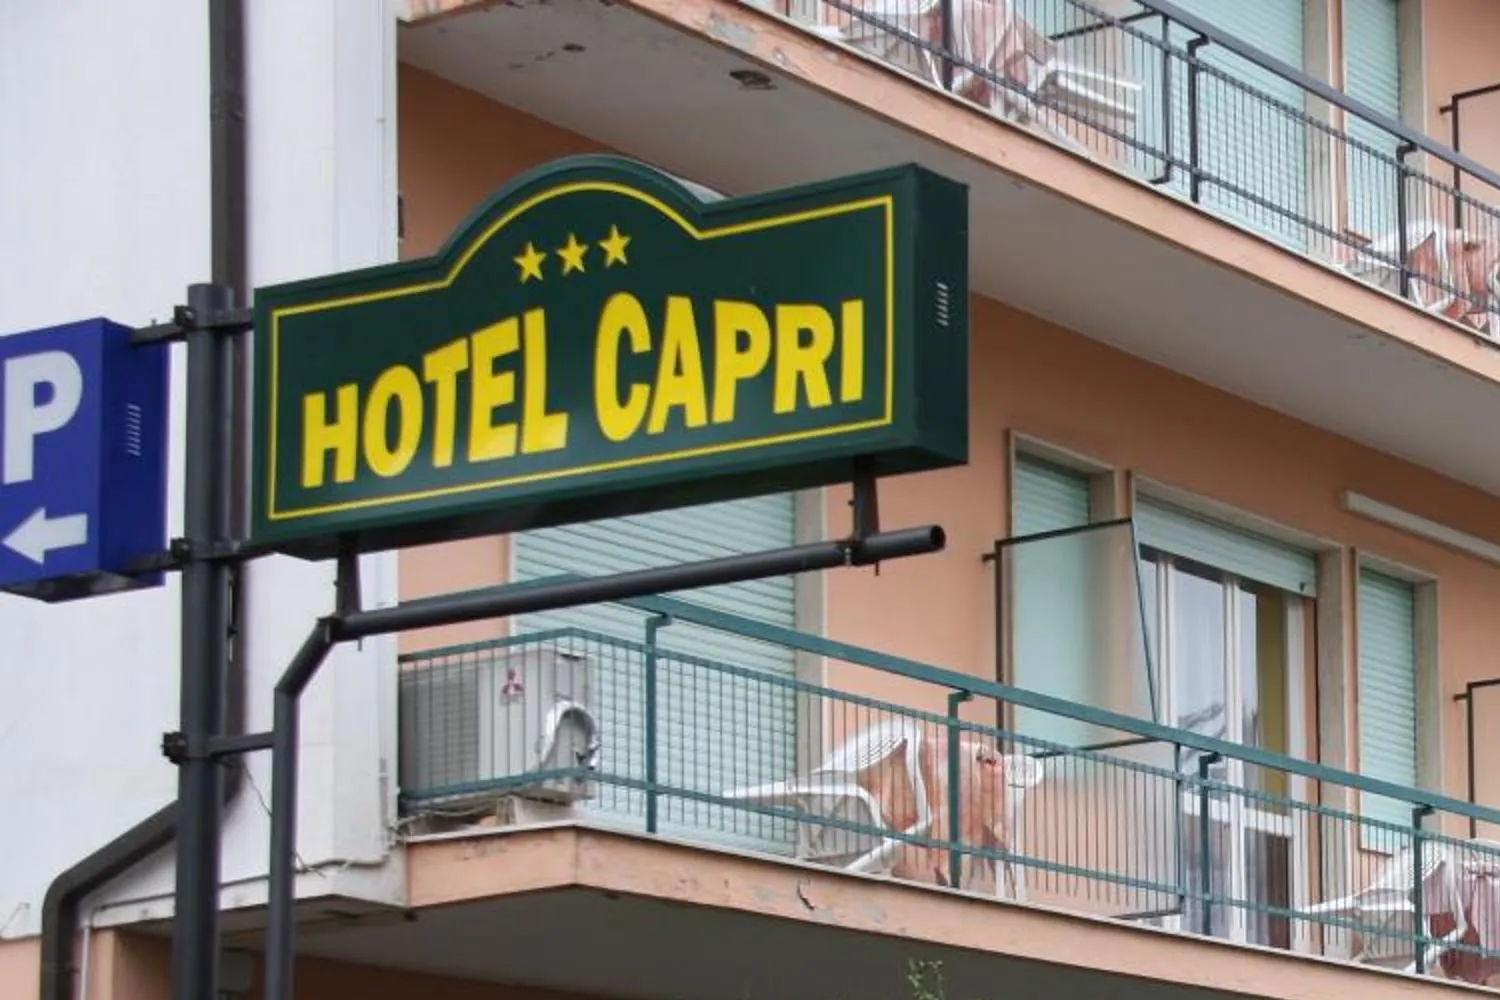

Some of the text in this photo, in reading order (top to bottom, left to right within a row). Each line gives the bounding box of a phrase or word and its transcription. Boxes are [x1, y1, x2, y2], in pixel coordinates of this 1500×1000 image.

[3, 350, 83, 485] P
[301, 292, 864, 488] HOTEL CAPRI
